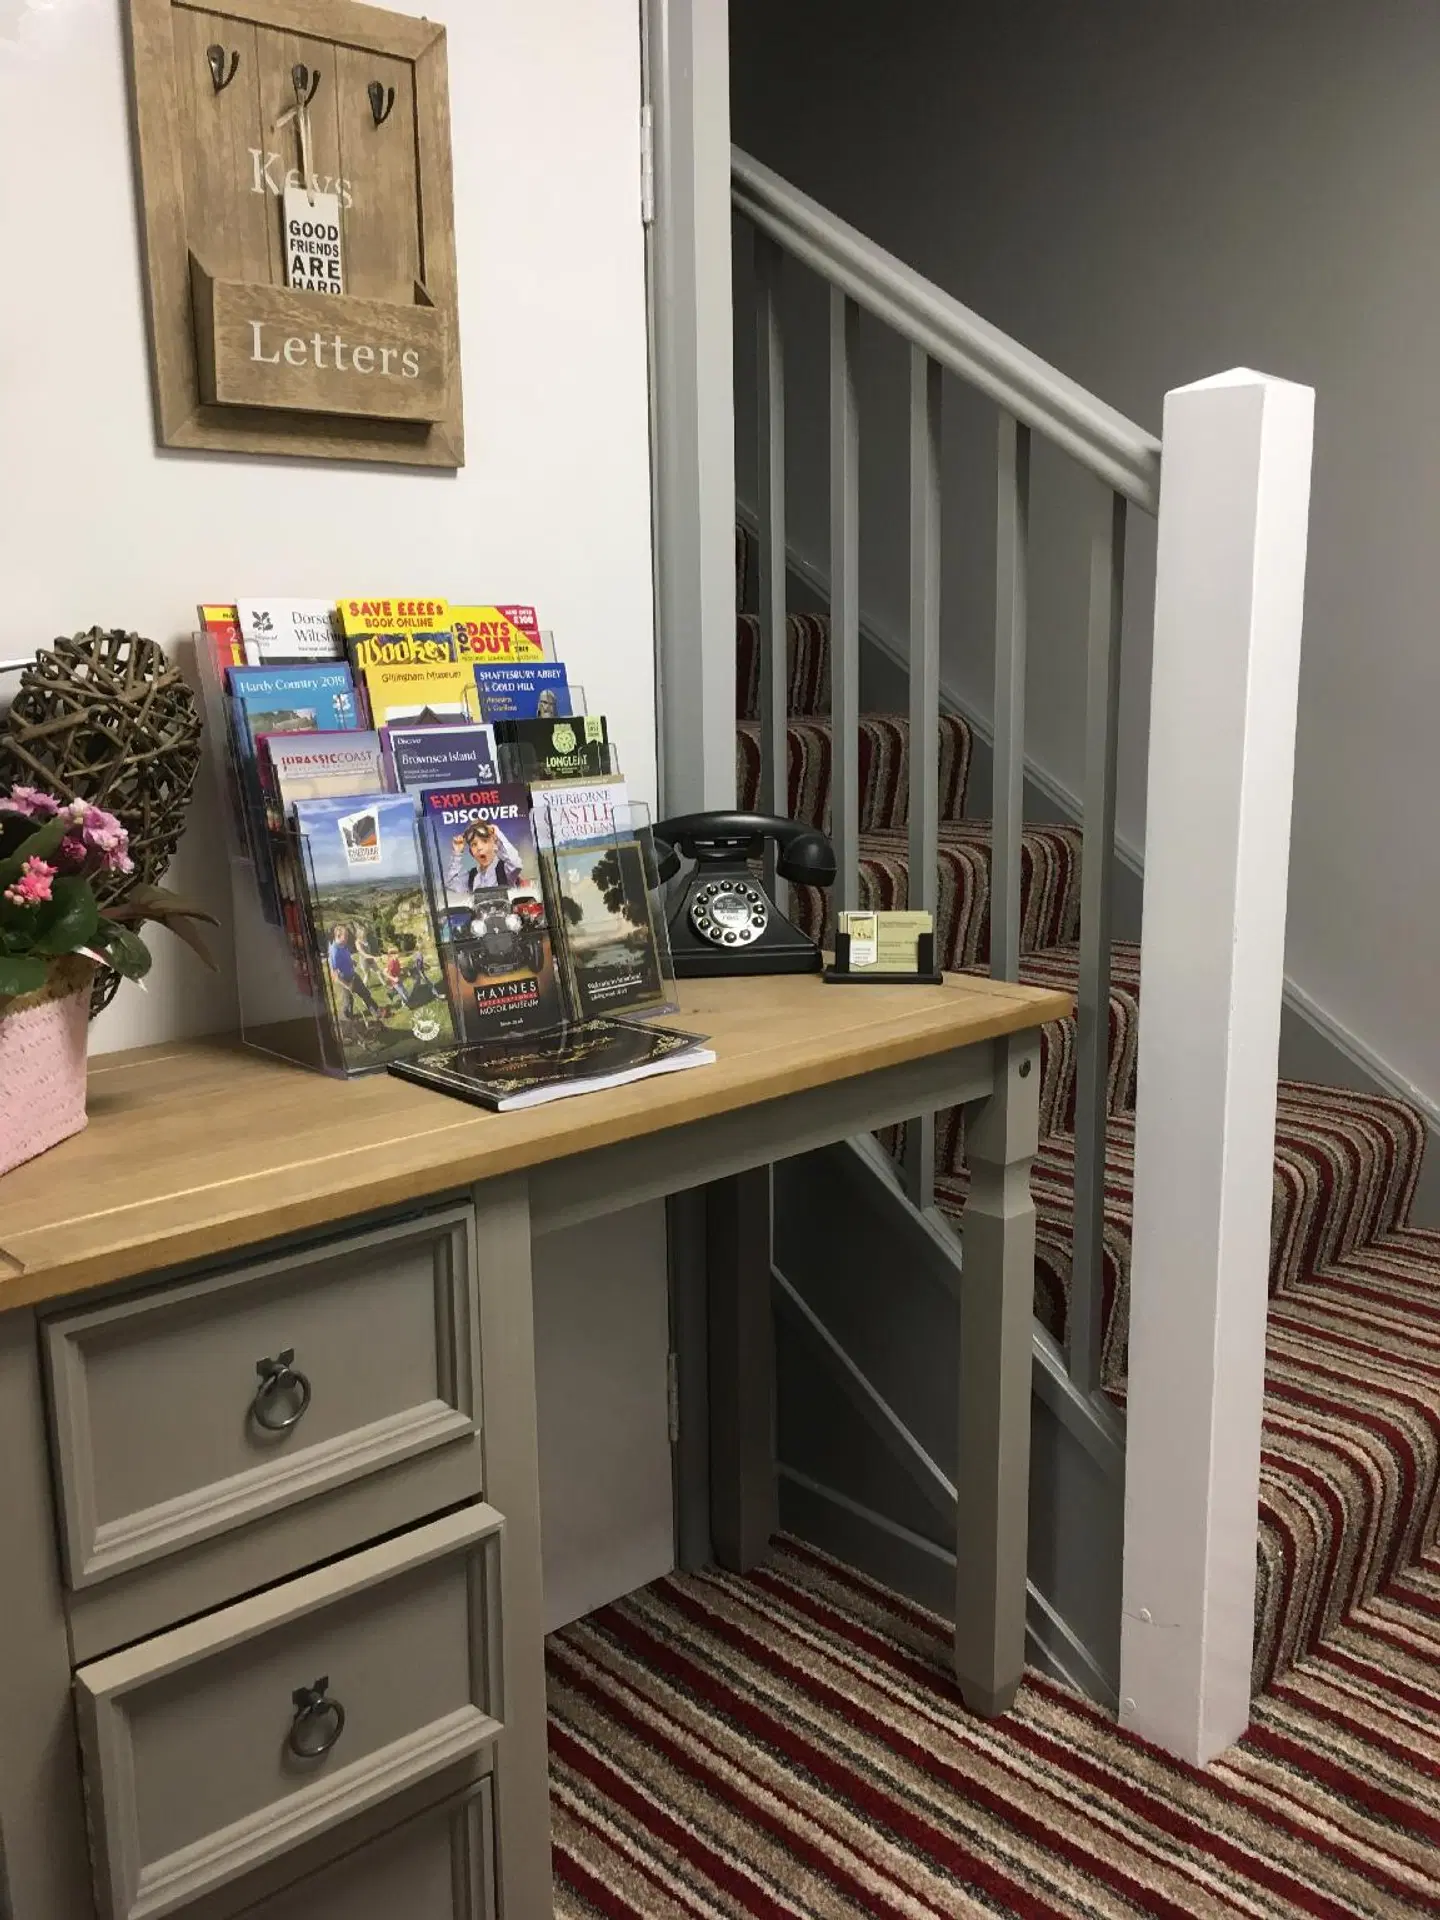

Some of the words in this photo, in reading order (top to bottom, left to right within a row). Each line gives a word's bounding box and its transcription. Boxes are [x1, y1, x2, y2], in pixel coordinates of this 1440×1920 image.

[289, 219, 339, 241] GOOD
[290, 238, 340, 257] FRIENDS
[291, 254, 341, 280] ARE
[248, 319, 420, 378] Letters
[349, 601, 392, 617] SAVE
[364, 617, 395, 628] BOOK
[396, 617, 434, 628] ONLINE
[465, 621, 510, 636] DAYS
[454, 622, 470, 653] TOP
[470, 636, 511, 654] OUT
[355, 629, 450, 669] Wookey
[480, 670, 535, 680] SHAFTESBURY
[536, 669, 561, 679] ABBEY
[240, 680, 273, 694] Hardy
[275, 678, 319, 692] Country
[320, 675, 346, 688] 2019
[402, 753, 448, 765] Brownsea
[448, 749, 478, 762] Island
[430, 790, 500, 809] EXPLORE
[542, 789, 611, 806] SHERBORNE
[477, 980, 537, 1001] HAYNES
